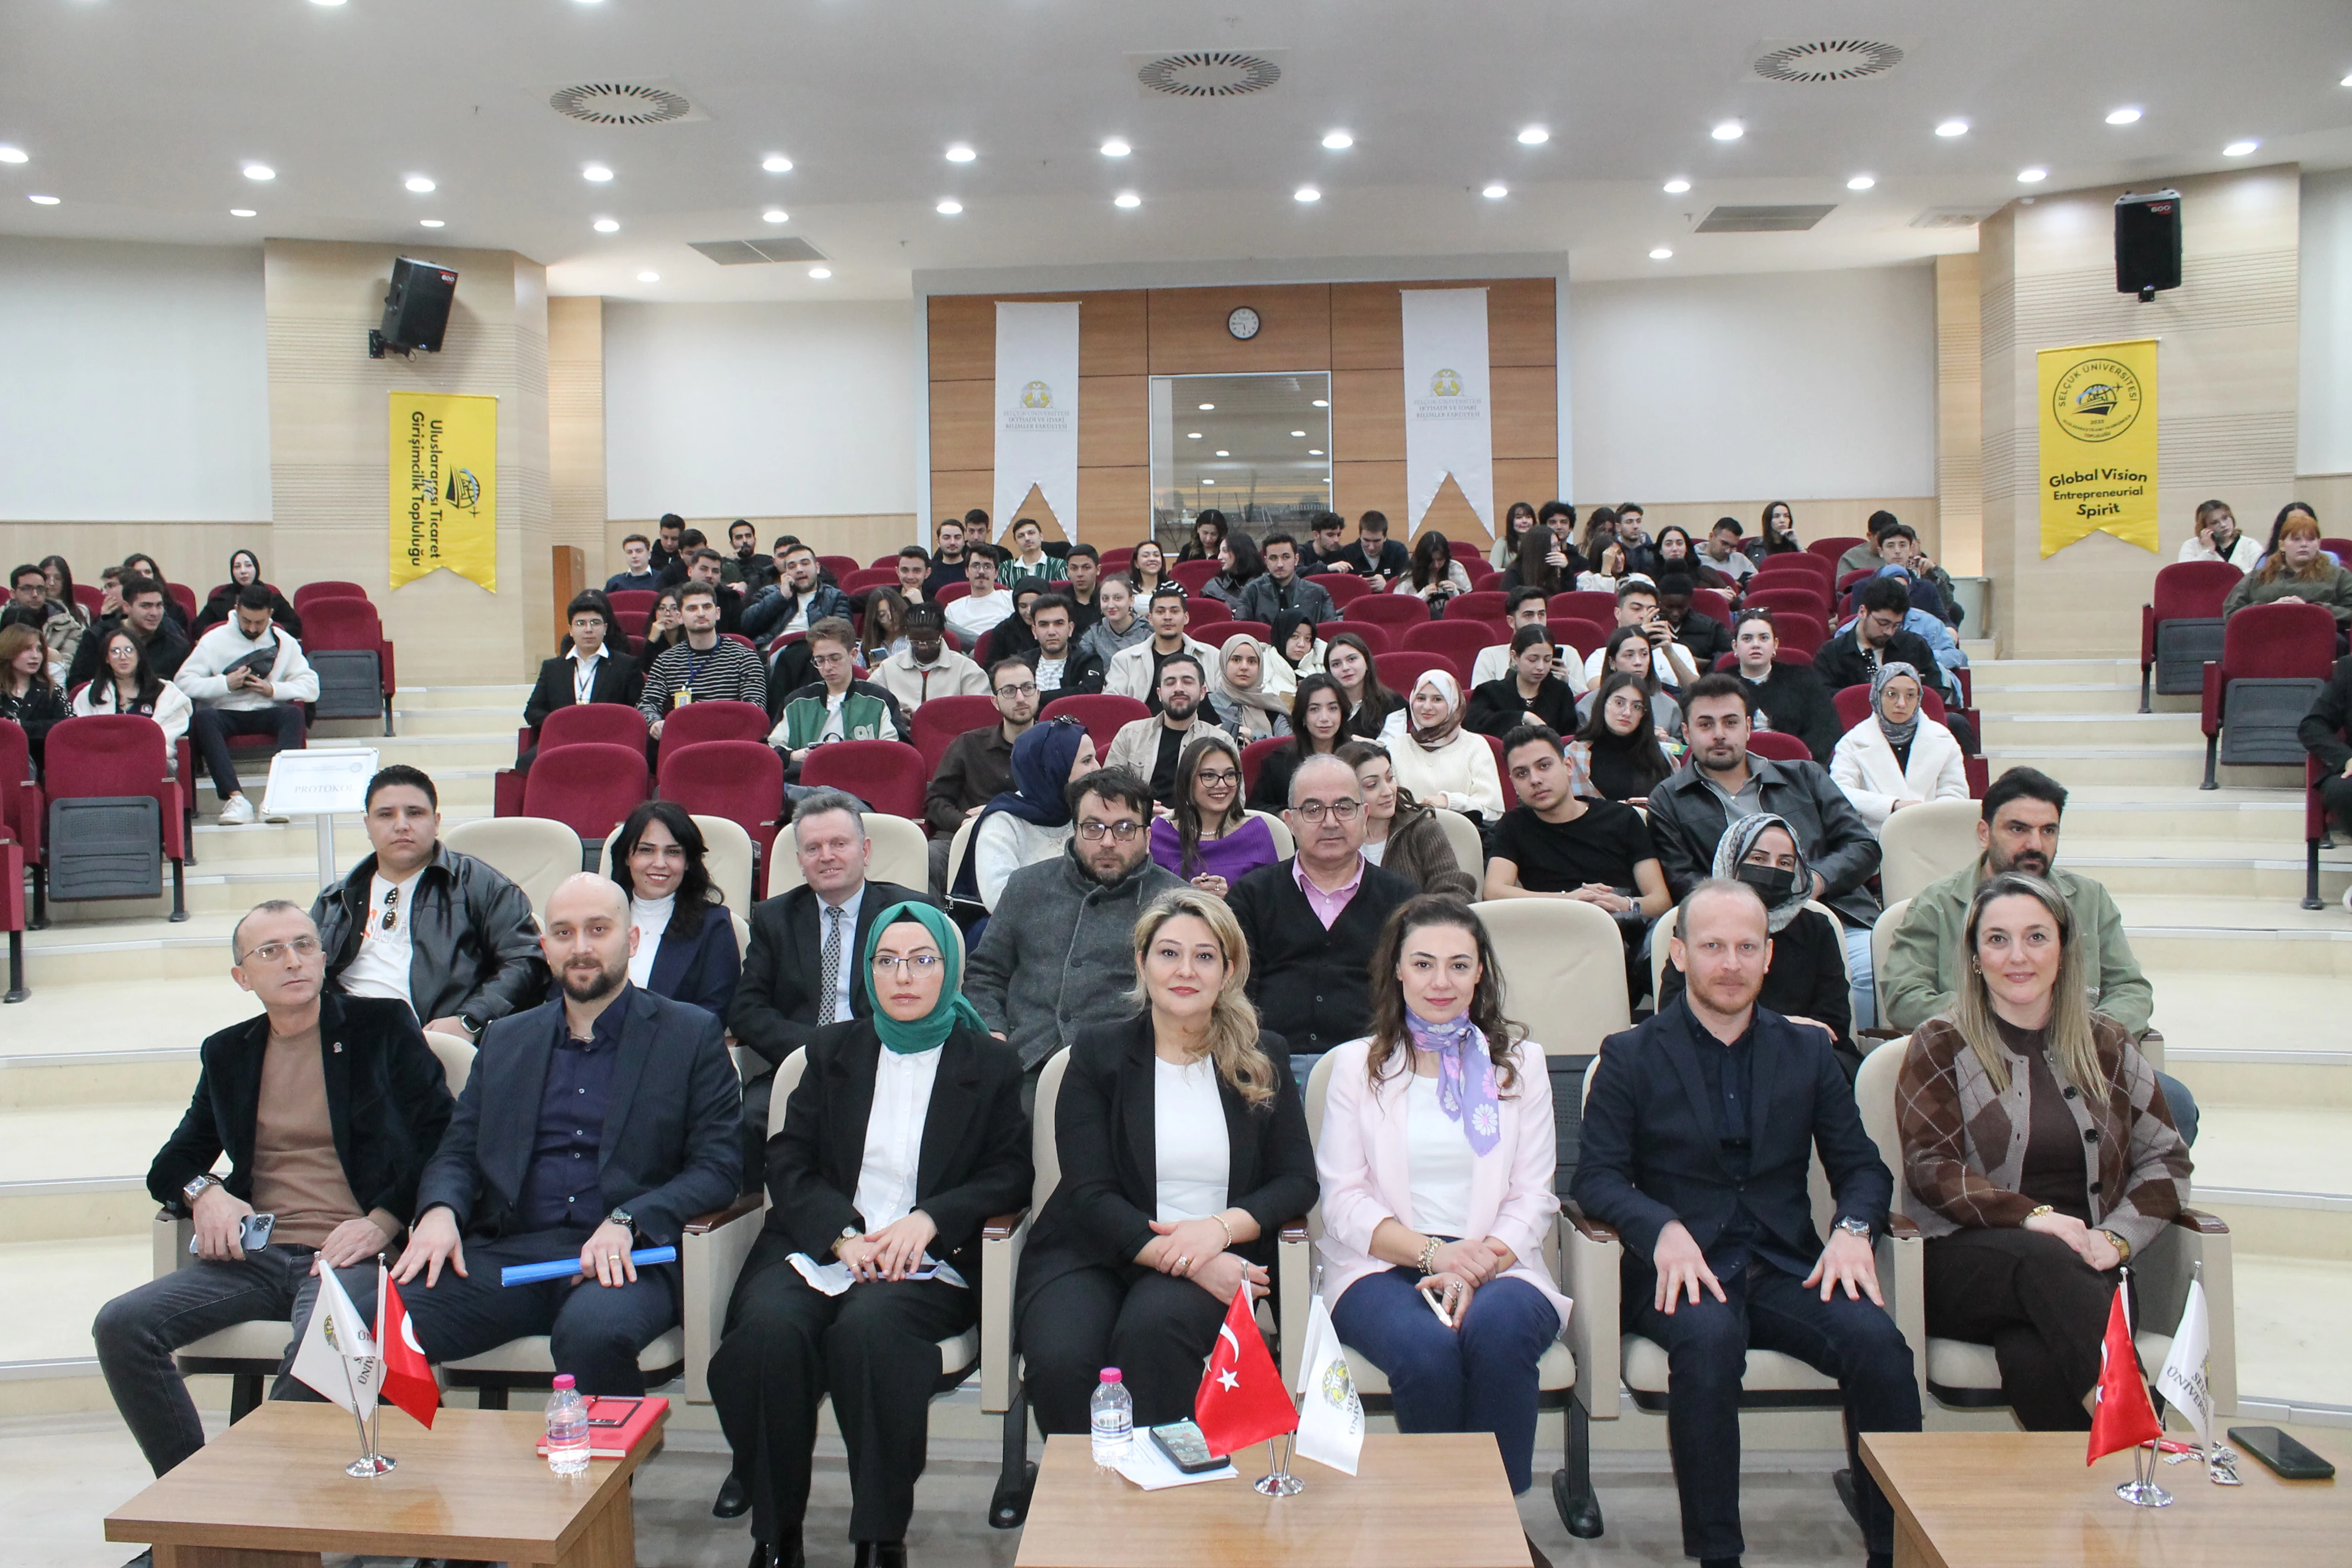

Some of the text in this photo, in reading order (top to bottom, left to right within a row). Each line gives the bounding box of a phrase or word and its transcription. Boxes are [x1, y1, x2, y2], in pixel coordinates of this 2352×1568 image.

[2059, 361, 2138, 407] SELÇUK ÜNİVERSİTESİ
[2049, 468, 2147, 487] Global Vision
[407, 411, 425, 566] Girişimcilik Topluluğu
[430, 420, 443, 558] Uluslararası Ticaret
[2054, 486, 2143, 501] Entrepreneurial
[2076, 503, 2120, 519] Spirit
[294, 784, 356, 793] PROTOKOL
